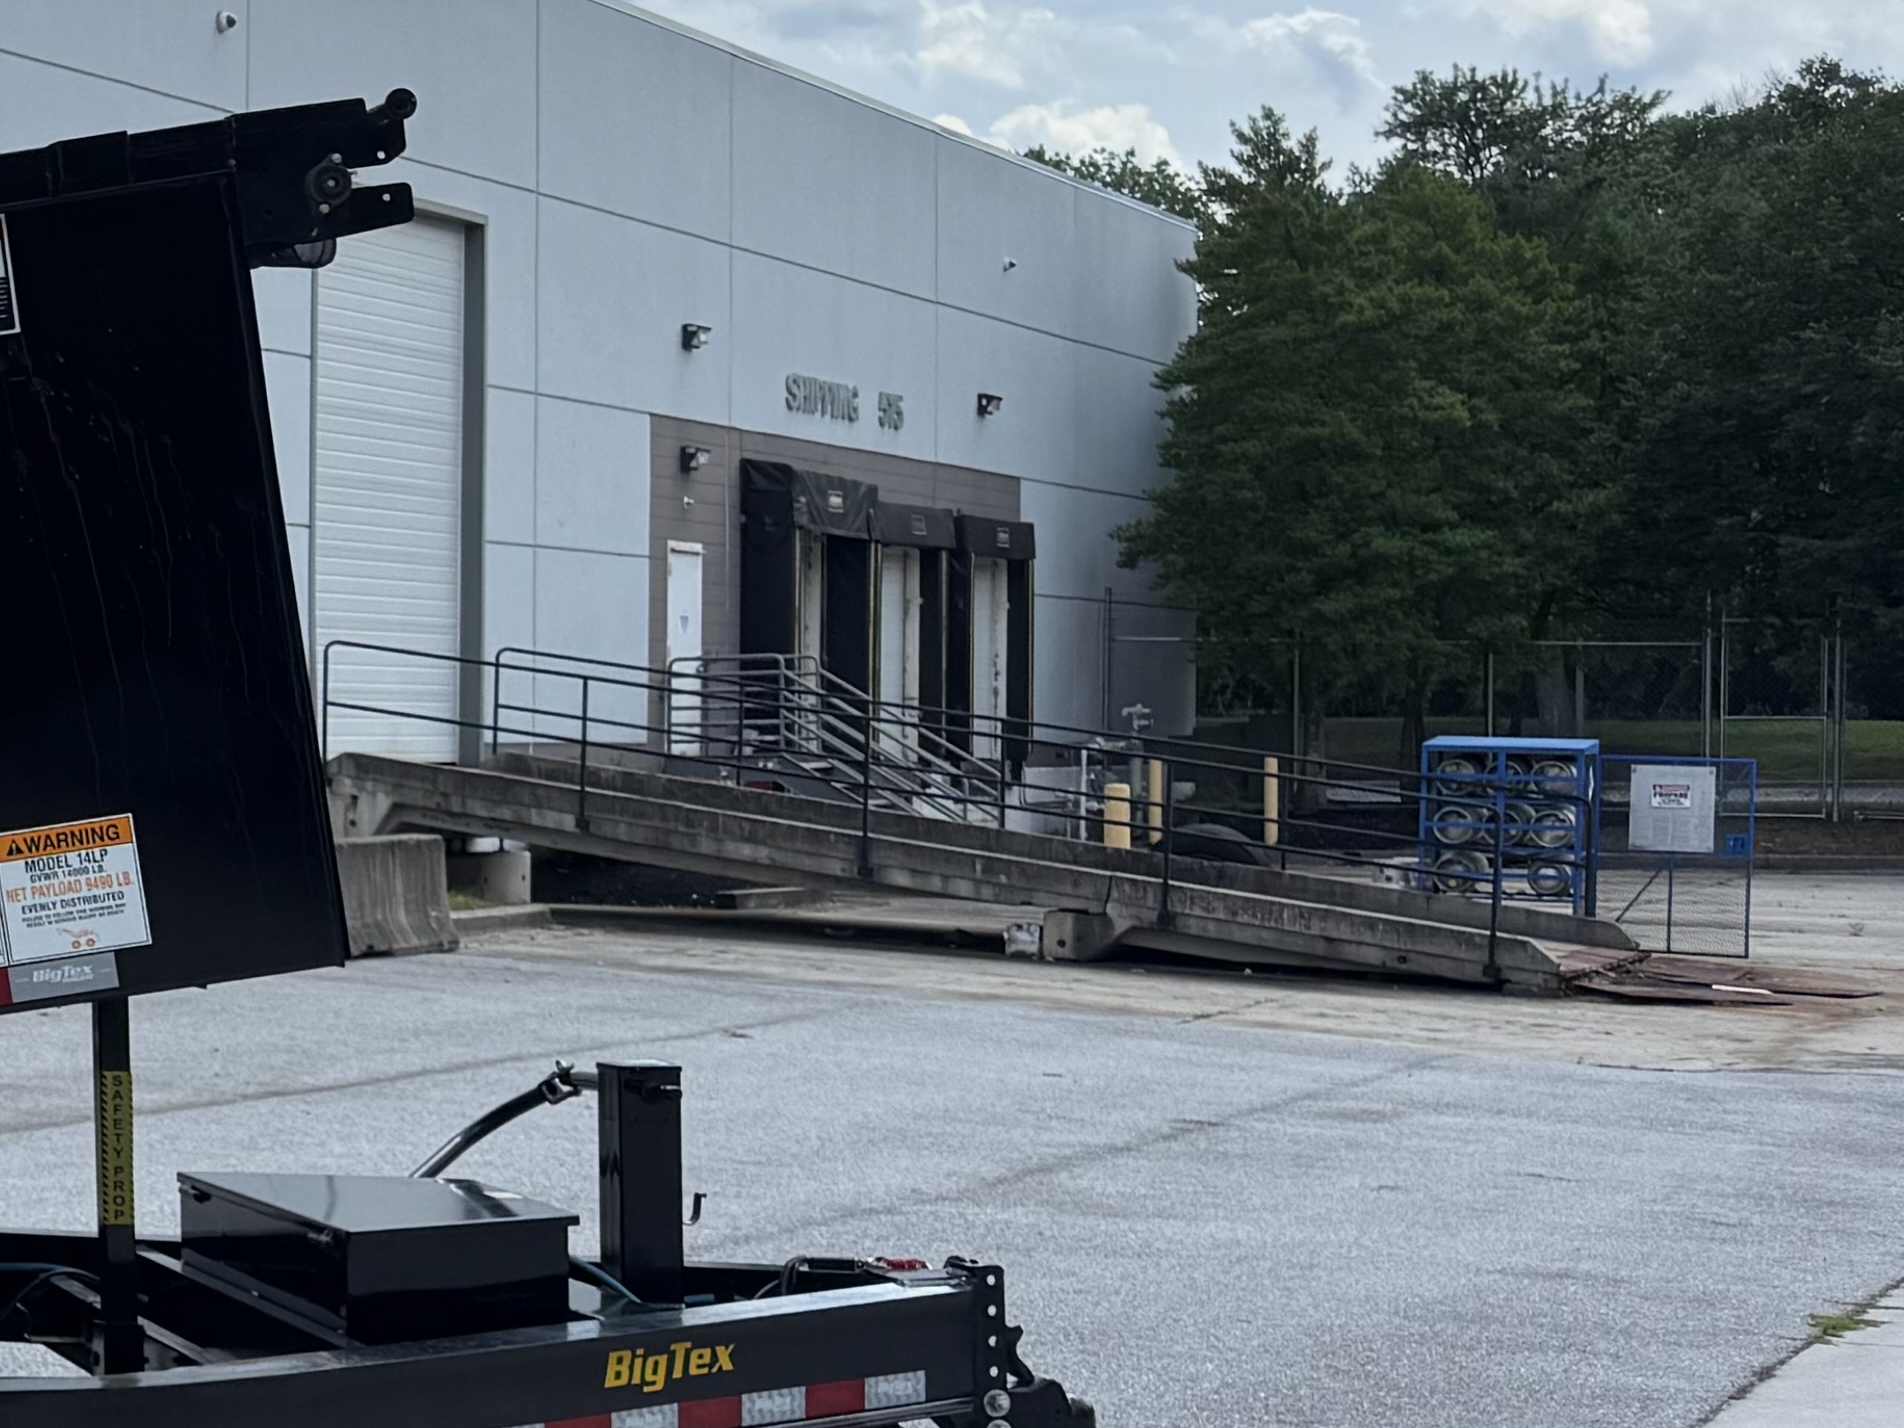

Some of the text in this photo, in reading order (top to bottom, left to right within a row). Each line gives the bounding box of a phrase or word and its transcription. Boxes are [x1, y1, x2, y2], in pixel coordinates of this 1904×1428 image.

[785, 372, 859, 423] SHIPPING
[23, 824, 120, 854] WARNING
[25, 848, 109, 874] MODEL 14LP
[30, 871, 59, 884] GVWR
[6, 887, 27, 903] NET
[32, 880, 82, 900] PAYLOAD
[22, 900, 57, 915] EVENLY
[61, 891, 125, 910] DISTRIBUTED
[32, 964, 94, 983] BigTex
[112, 1075, 126, 1222] SAFETY PROP
[604, 1341, 736, 1393] BigTex
